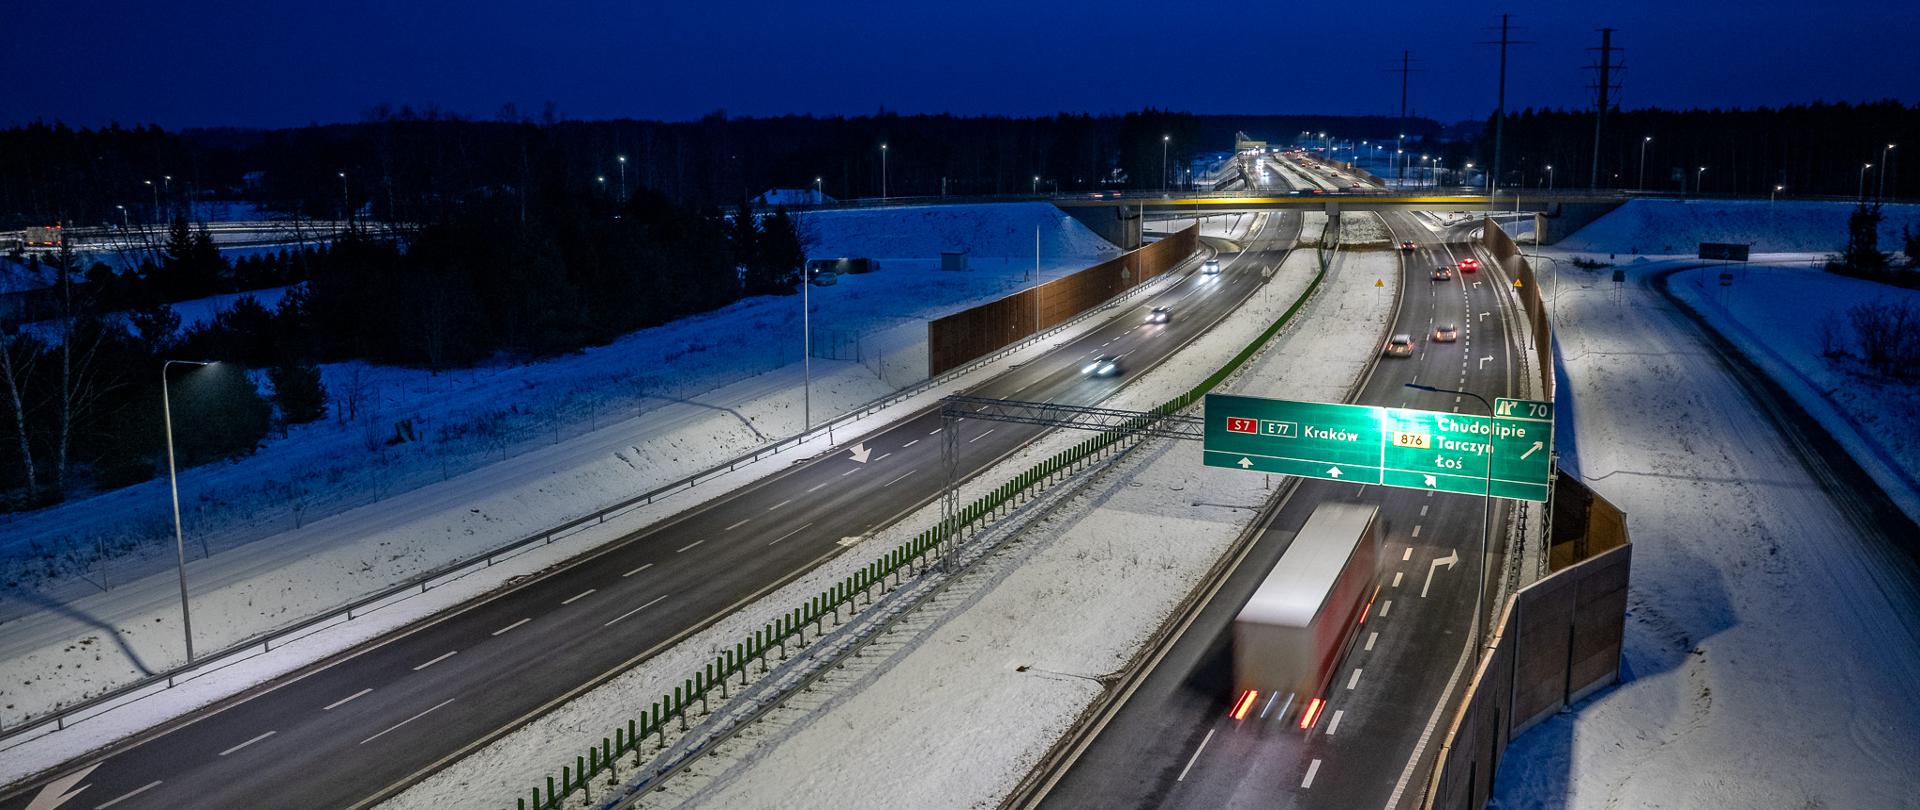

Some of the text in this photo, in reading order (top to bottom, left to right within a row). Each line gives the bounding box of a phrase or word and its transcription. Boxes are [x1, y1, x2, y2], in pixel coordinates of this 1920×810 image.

[1528, 403, 1548, 417] 70
[1234, 420, 1359, 442] S 7 E 77 Kraków
[1437, 418, 1526, 439] Chudolipie
[1400, 434, 1423, 446] 876
[1436, 436, 1495, 456] Tarczyn
[1435, 454, 1463, 469] Łoś
